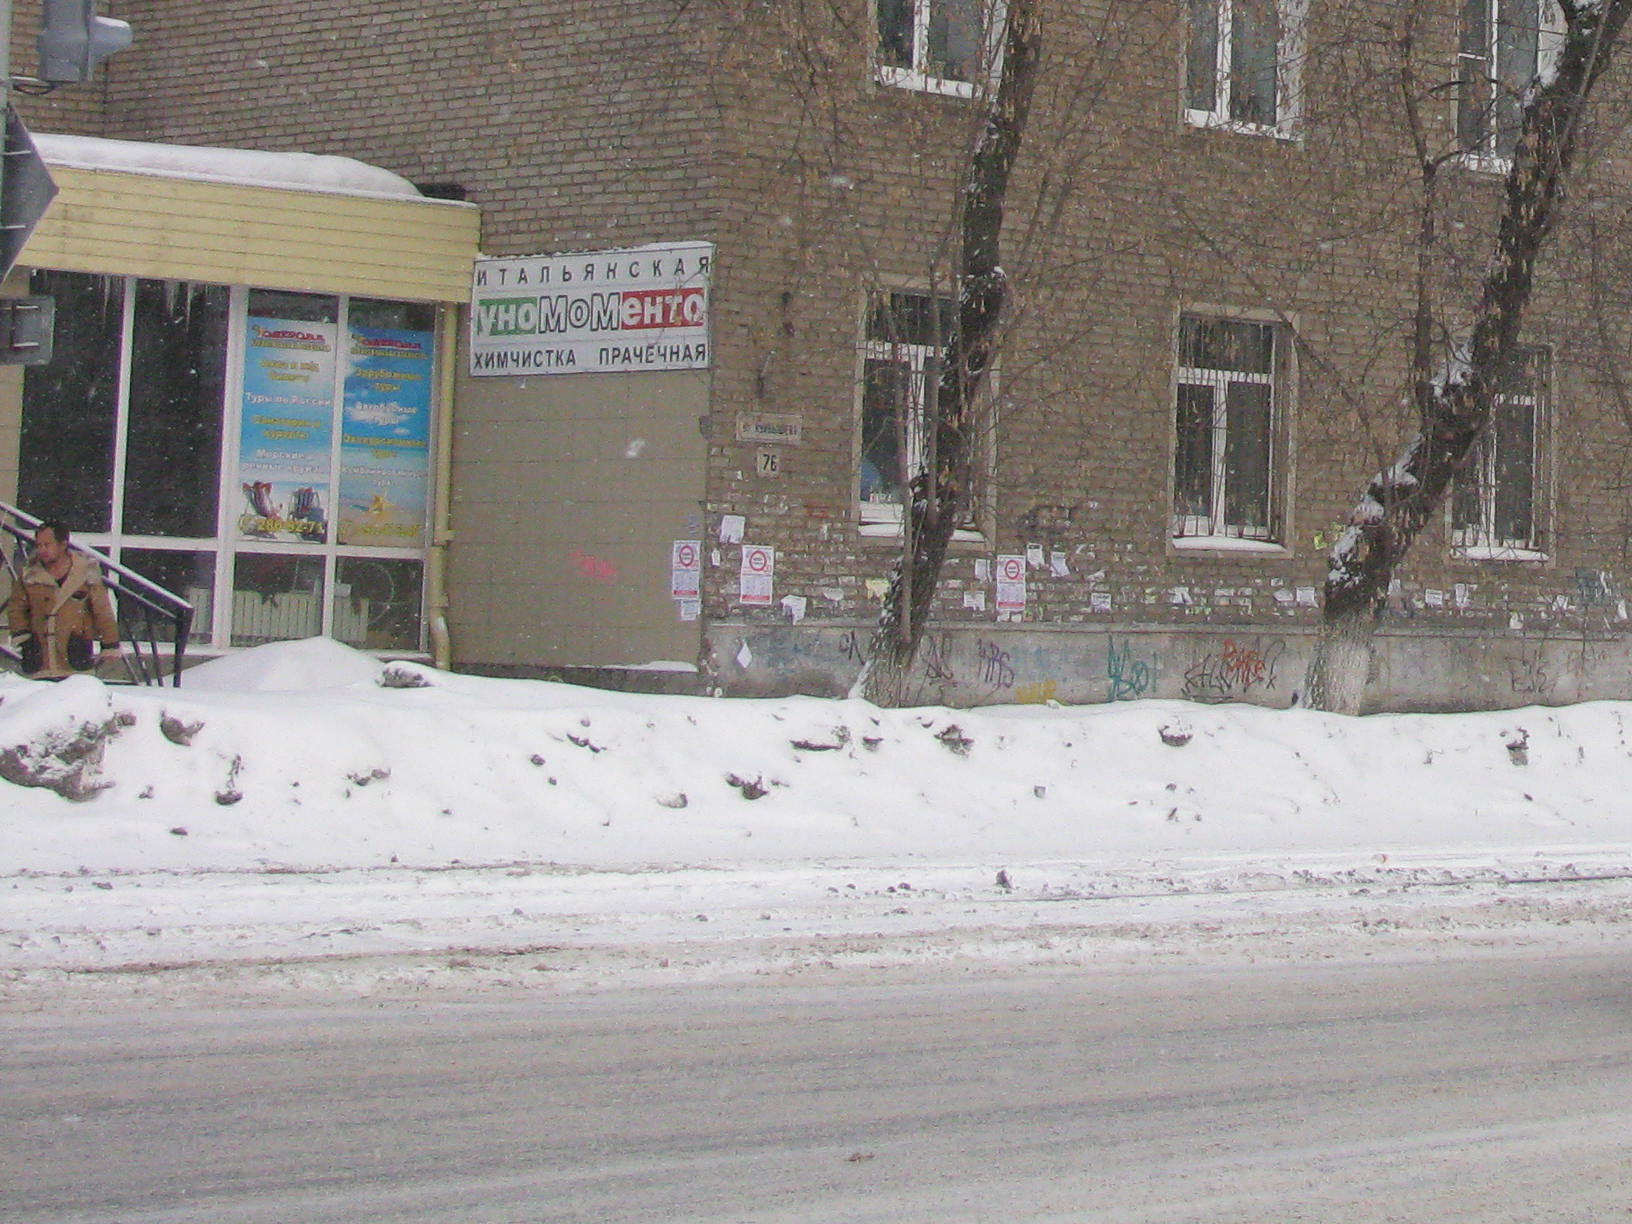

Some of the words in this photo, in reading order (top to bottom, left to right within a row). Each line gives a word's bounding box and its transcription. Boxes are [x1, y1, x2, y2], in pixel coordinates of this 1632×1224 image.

[477, 256, 709, 286] ИТАЛЬЯНСКАЯ
[474, 349, 577, 370] ХИМЧИСТКА
[600, 343, 706, 366] ПРАЧЕЧНАЯ
